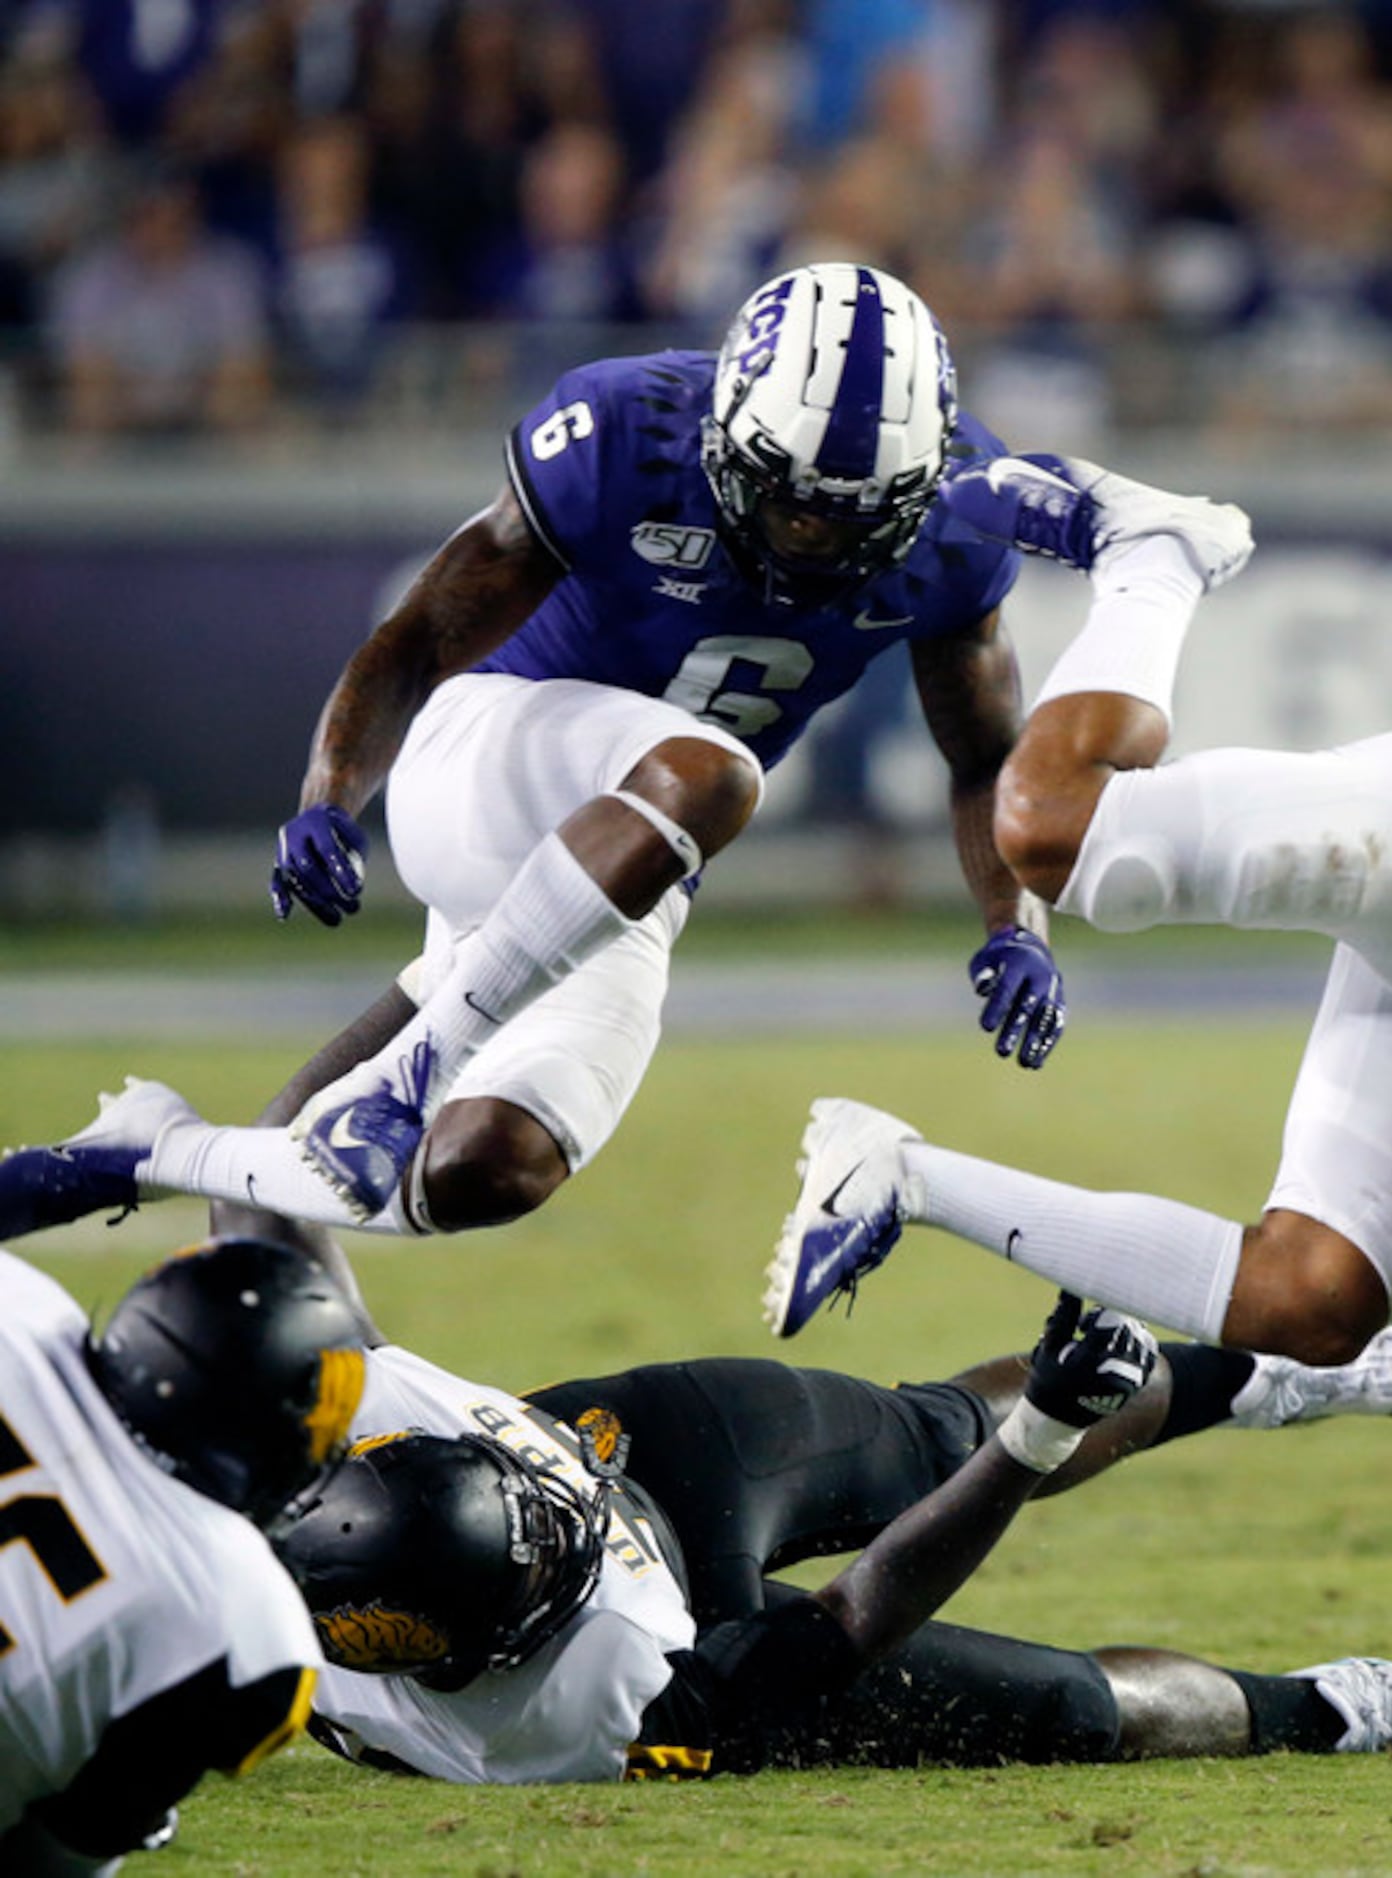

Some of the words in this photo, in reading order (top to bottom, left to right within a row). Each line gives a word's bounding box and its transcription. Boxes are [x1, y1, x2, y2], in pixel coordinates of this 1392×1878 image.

[530, 400, 595, 462] 6
[630, 520, 717, 571] 150
[660, 634, 816, 738] 6
